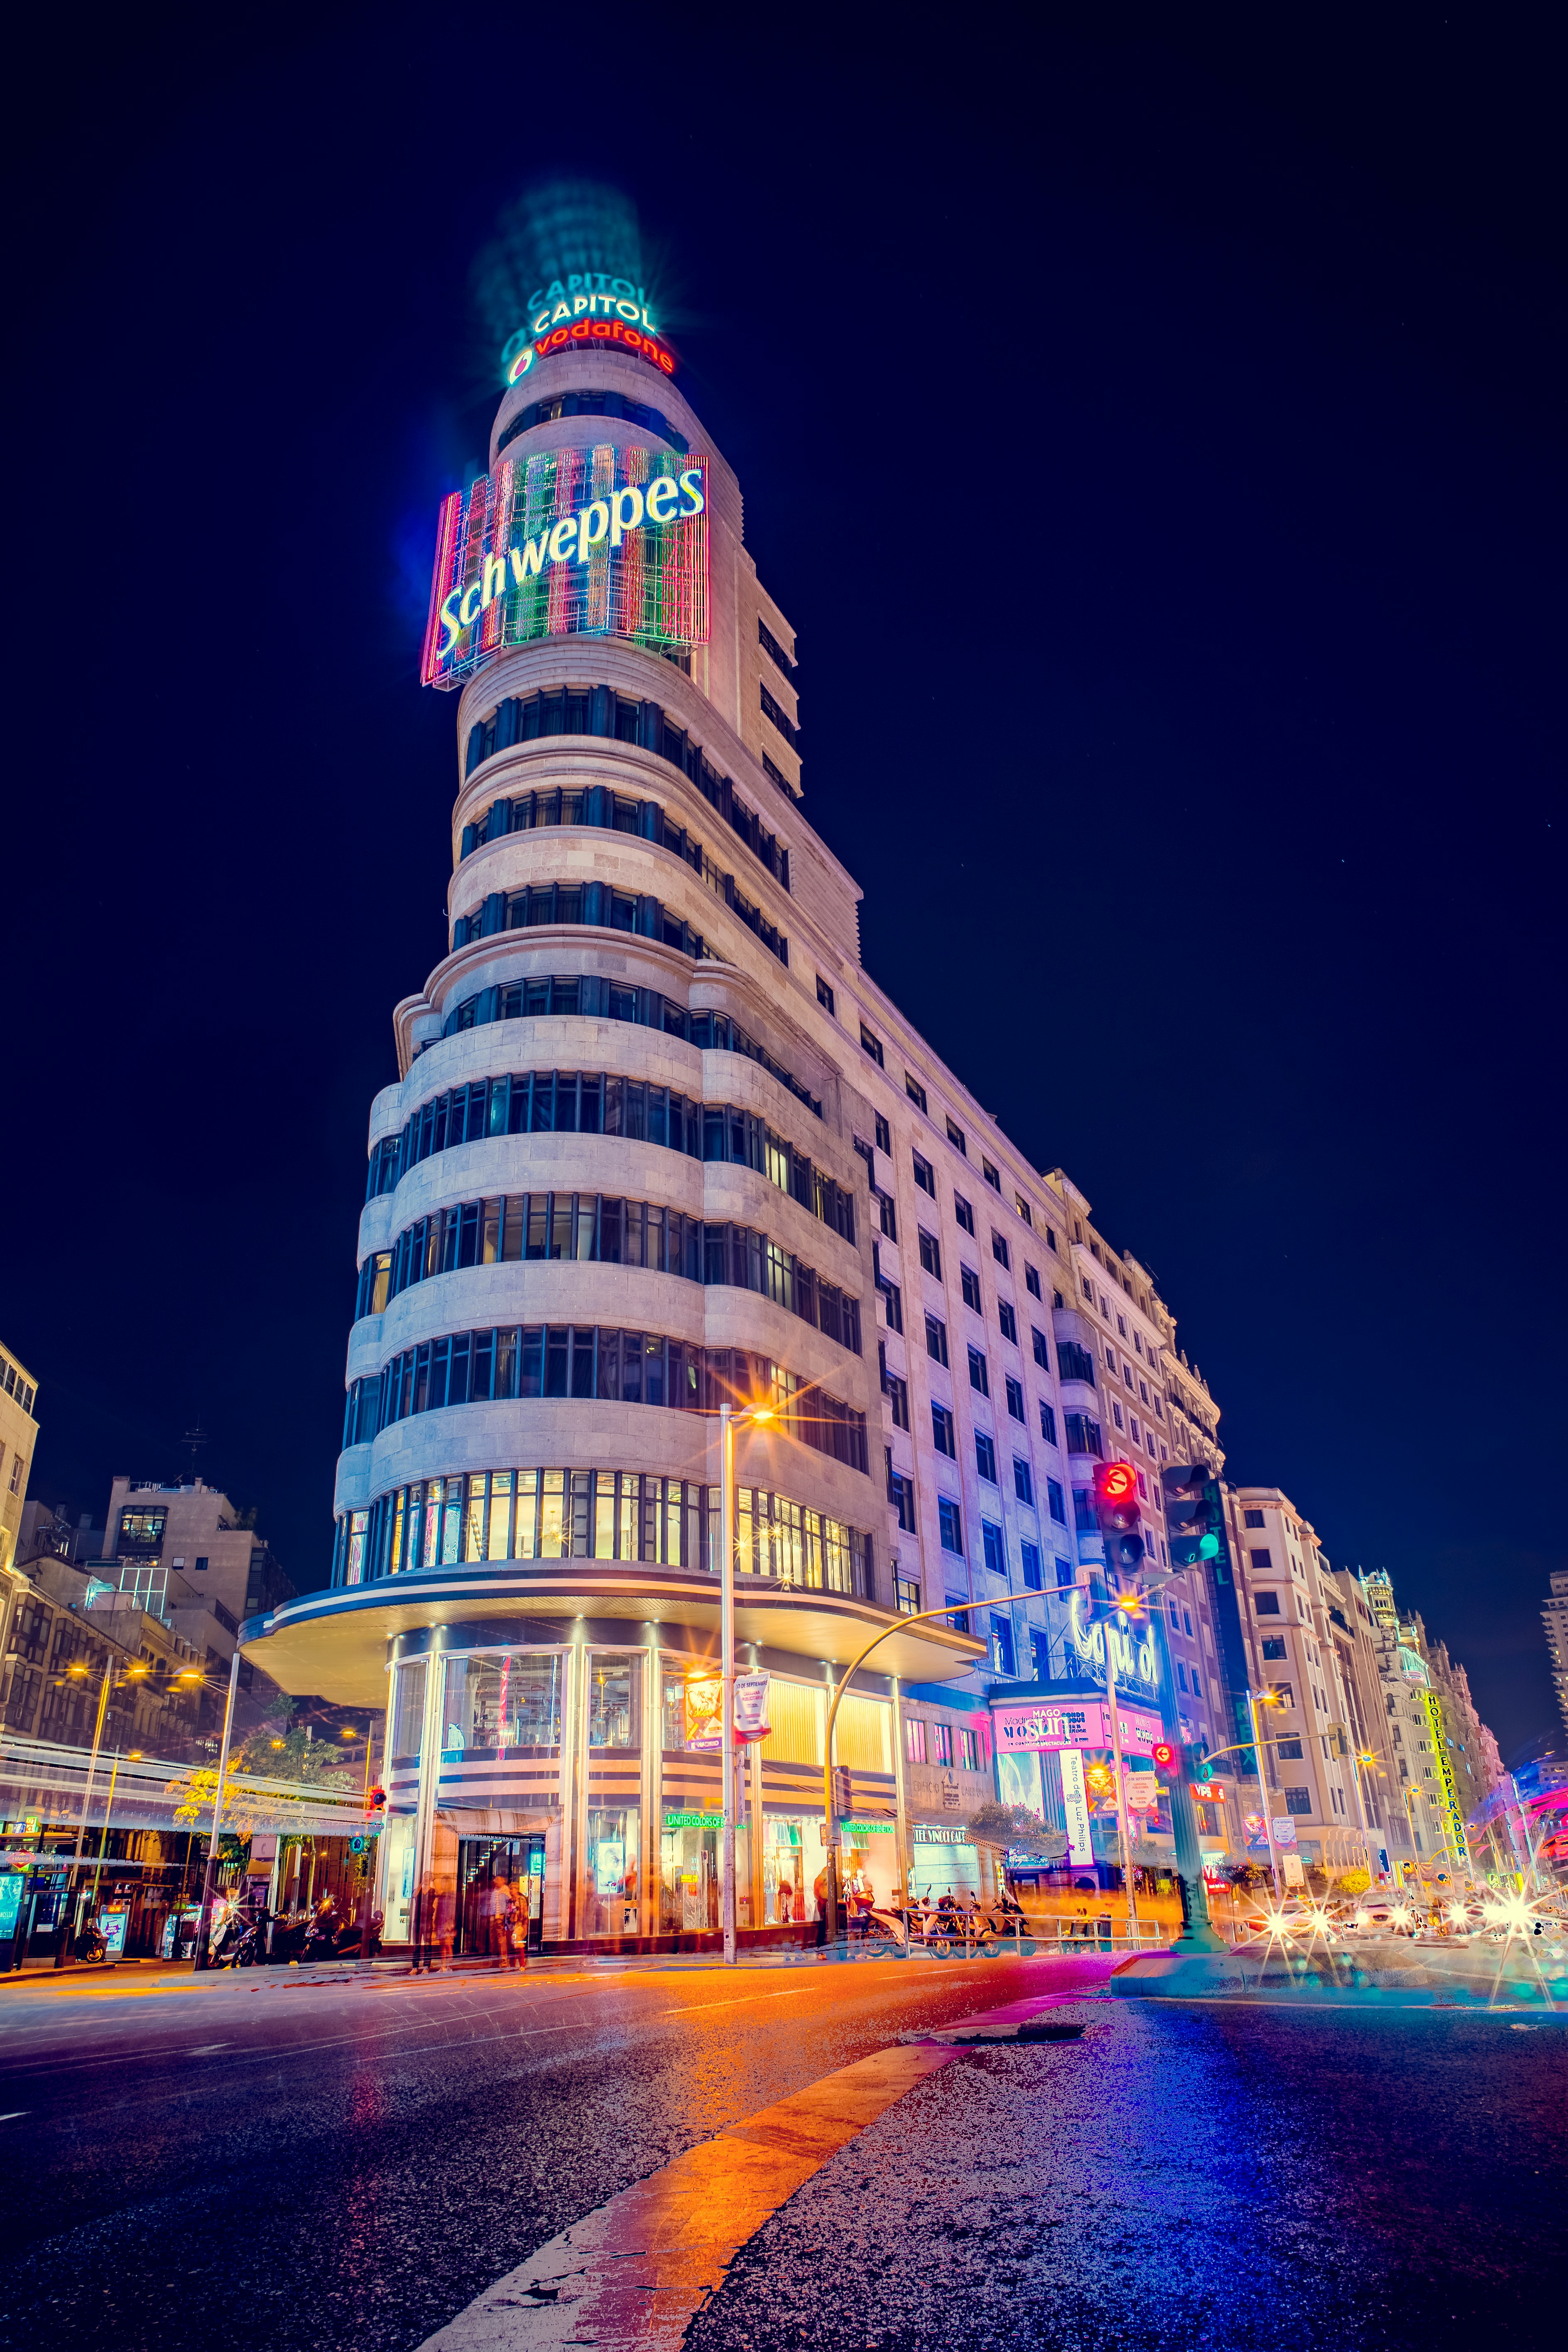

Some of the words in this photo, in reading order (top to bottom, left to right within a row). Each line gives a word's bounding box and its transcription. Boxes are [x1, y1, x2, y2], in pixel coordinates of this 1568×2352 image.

[534, 295, 657, 335] CAPITOL
[535, 318, 674, 374] vodafone
[436, 468, 705, 659] Schweppes
[1033, 1709, 1060, 1718] MAGO
[1236, 1702, 1257, 1766] REX
[1428, 1696, 1446, 1750] HOTEL
[1441, 1757, 1468, 1856] EMPERADOR
[914, 1781, 940, 1793] EDIFICIO
[1074, 1784, 1080, 1794] de
[1195, 1784, 1212, 1798] VIPS
[668, 1815, 691, 1825] UNITED
[691, 1817, 712, 1826] COLORS
[713, 1818, 720, 1827] OF
[857, 1824, 871, 1832] COLORS
